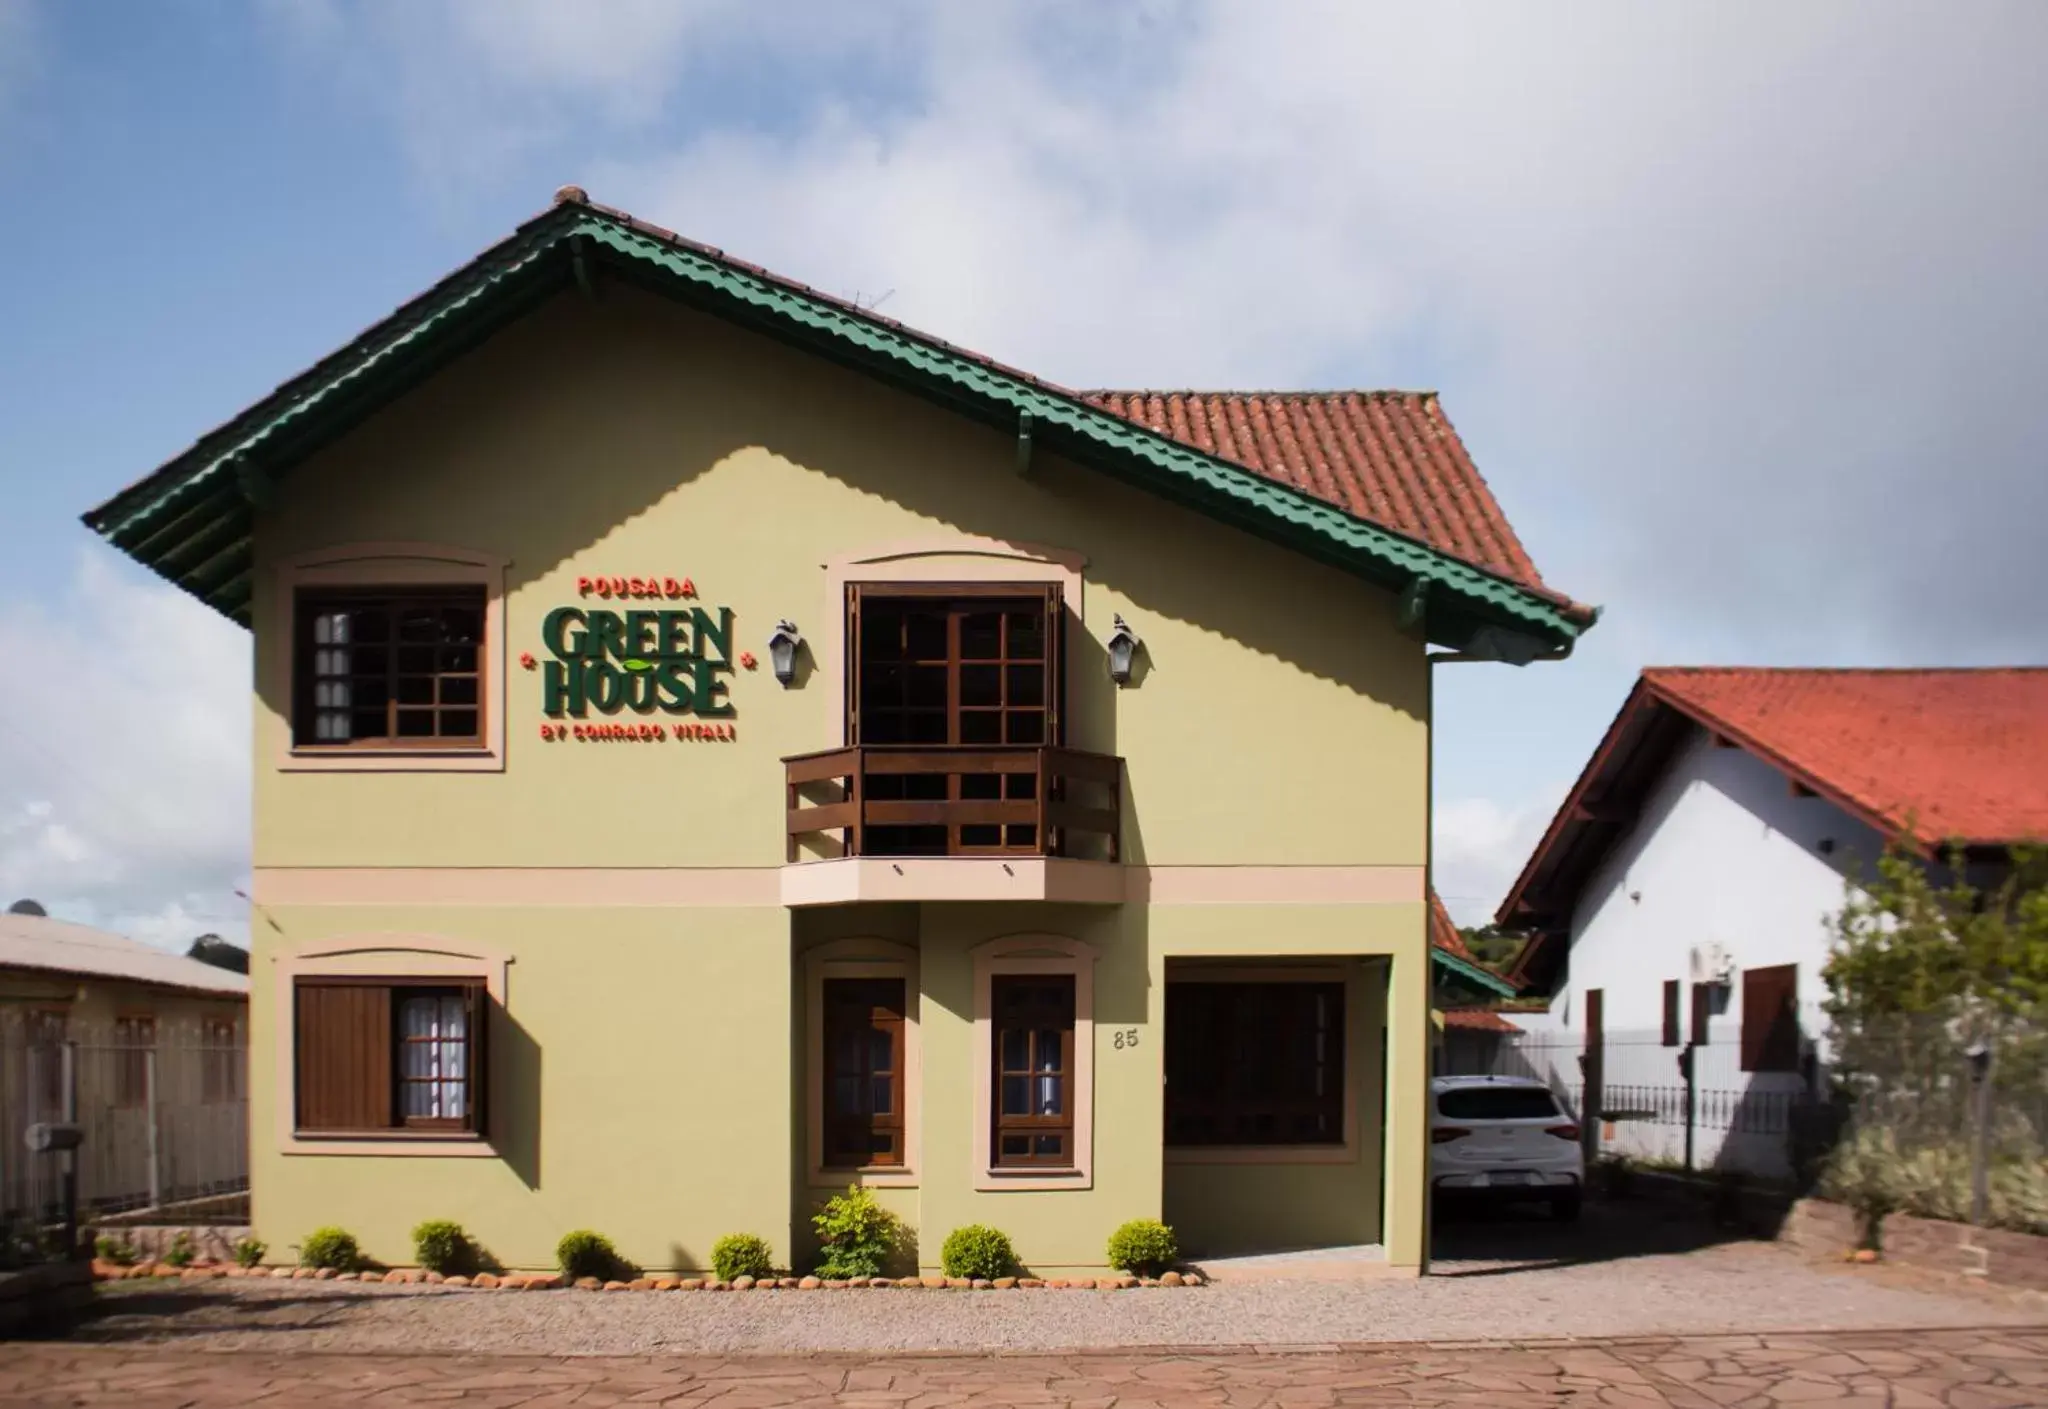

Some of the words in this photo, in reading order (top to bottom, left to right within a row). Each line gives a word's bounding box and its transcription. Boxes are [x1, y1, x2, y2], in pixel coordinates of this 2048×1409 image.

[577, 576, 698, 599] POUSADA
[542, 606, 735, 671] GREEN
[542, 659, 736, 718] HOUSE
[540, 723, 567, 742] BY
[573, 723, 666, 742] CONRADO
[672, 723, 736, 742] VITALI
[1114, 1028, 1139, 1050] 85
